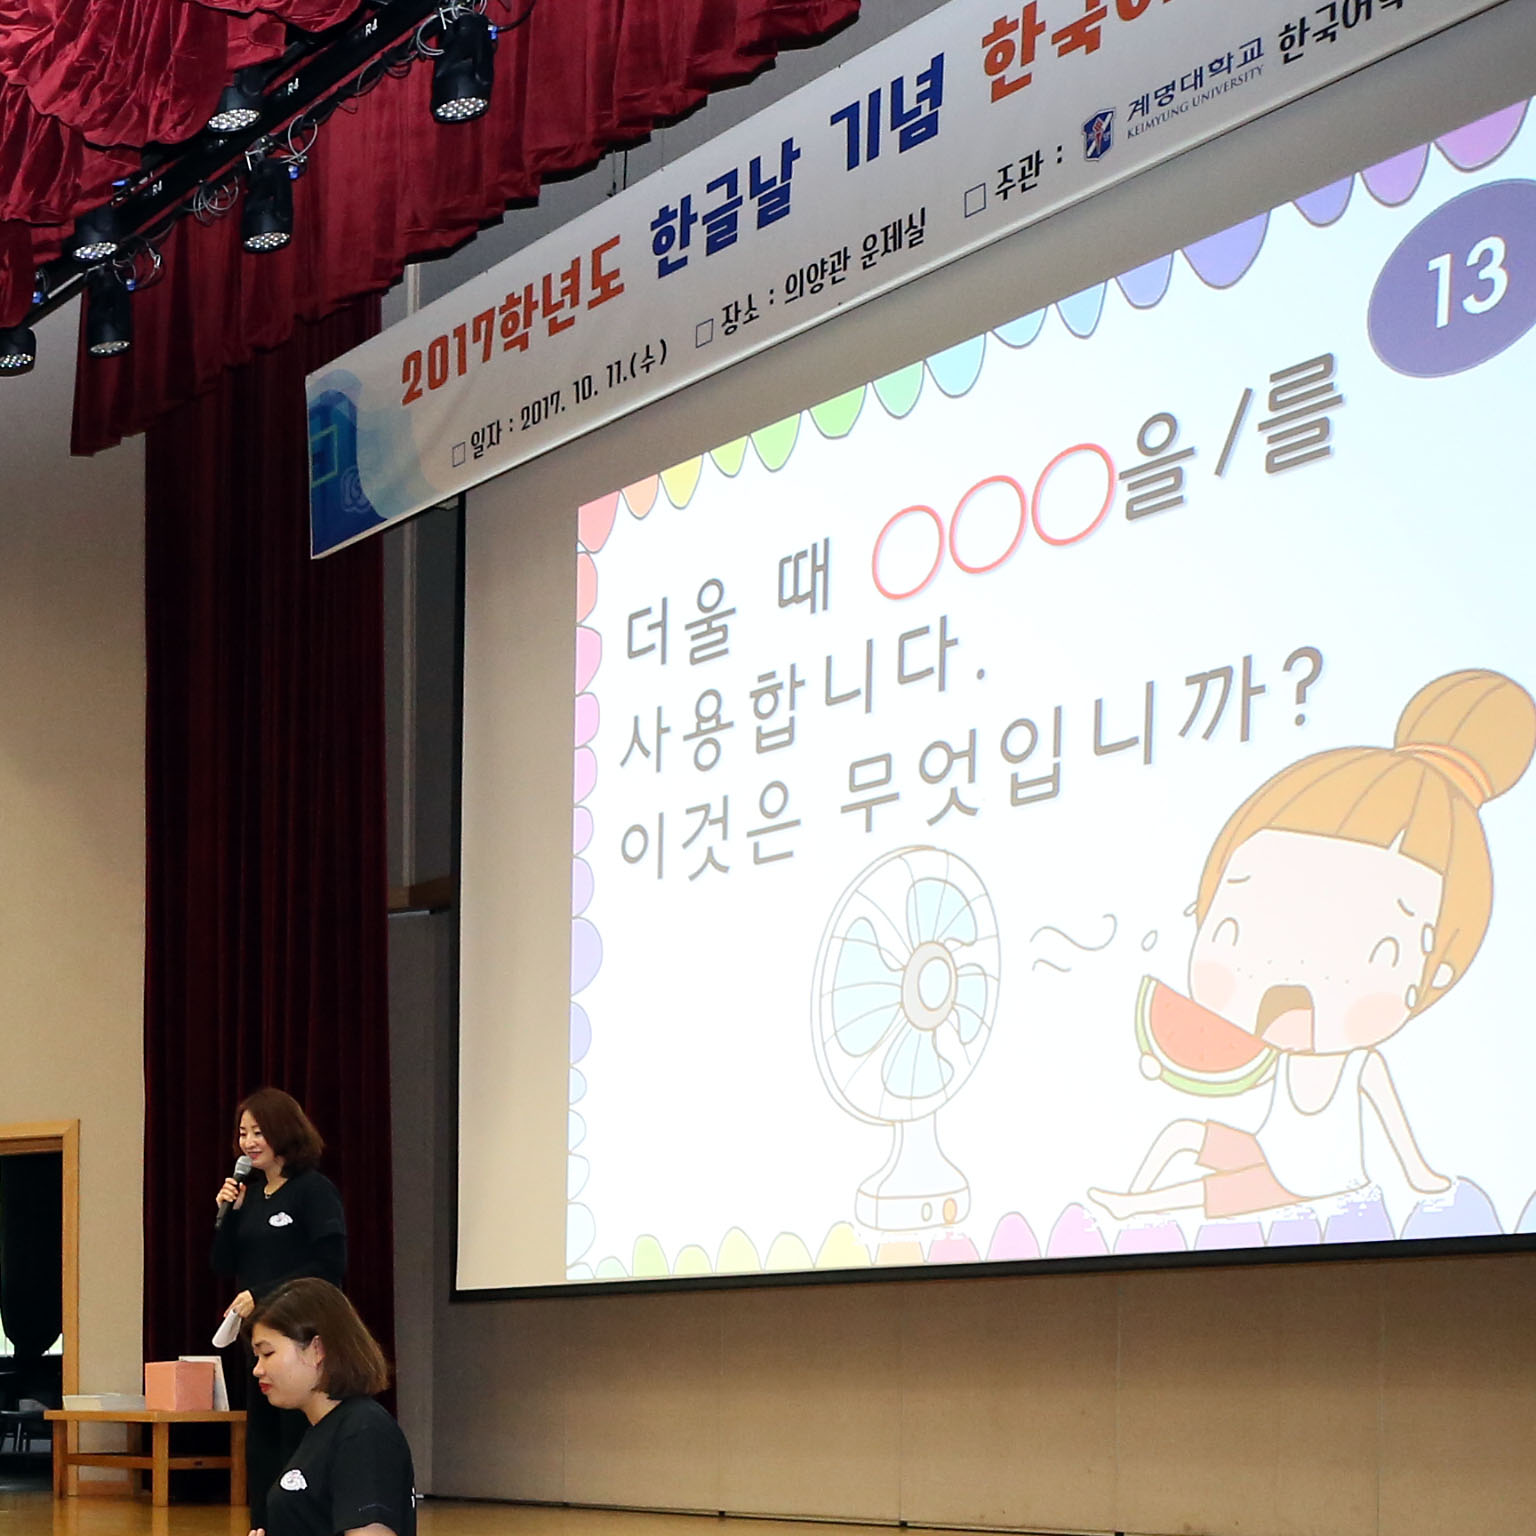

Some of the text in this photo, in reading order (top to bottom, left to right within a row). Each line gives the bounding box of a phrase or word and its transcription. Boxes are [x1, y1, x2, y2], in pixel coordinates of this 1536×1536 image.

[1127, 63, 1266, 141] KEIMYUNG UNIVERSITY
[401, 234, 625, 406] 2017학년도
[650, 137, 801, 280] 한글날
[830, 51, 945, 172] 기념
[470, 419, 503, 460] 일자
[520, 390, 567, 431] 2017.
[573, 374, 600, 405] 10.
[606, 338, 669, 389] 11.(수)
[720, 293, 761, 337] 장소
[783, 246, 852, 305] 의양관
[859, 206, 927, 271] 운제실
[994, 148, 1045, 202] 주관
[1127, 36, 1266, 123] 계명대학교
[1278, 0, 1404, 65] 한국어
[1427, 235, 1509, 329] 13
[625, 575, 738, 669] 더울
[777, 536, 835, 615] 때
[618, 614, 989, 778] 사용합니다.
[618, 644, 1327, 884] 이것은 무엇입니까?
